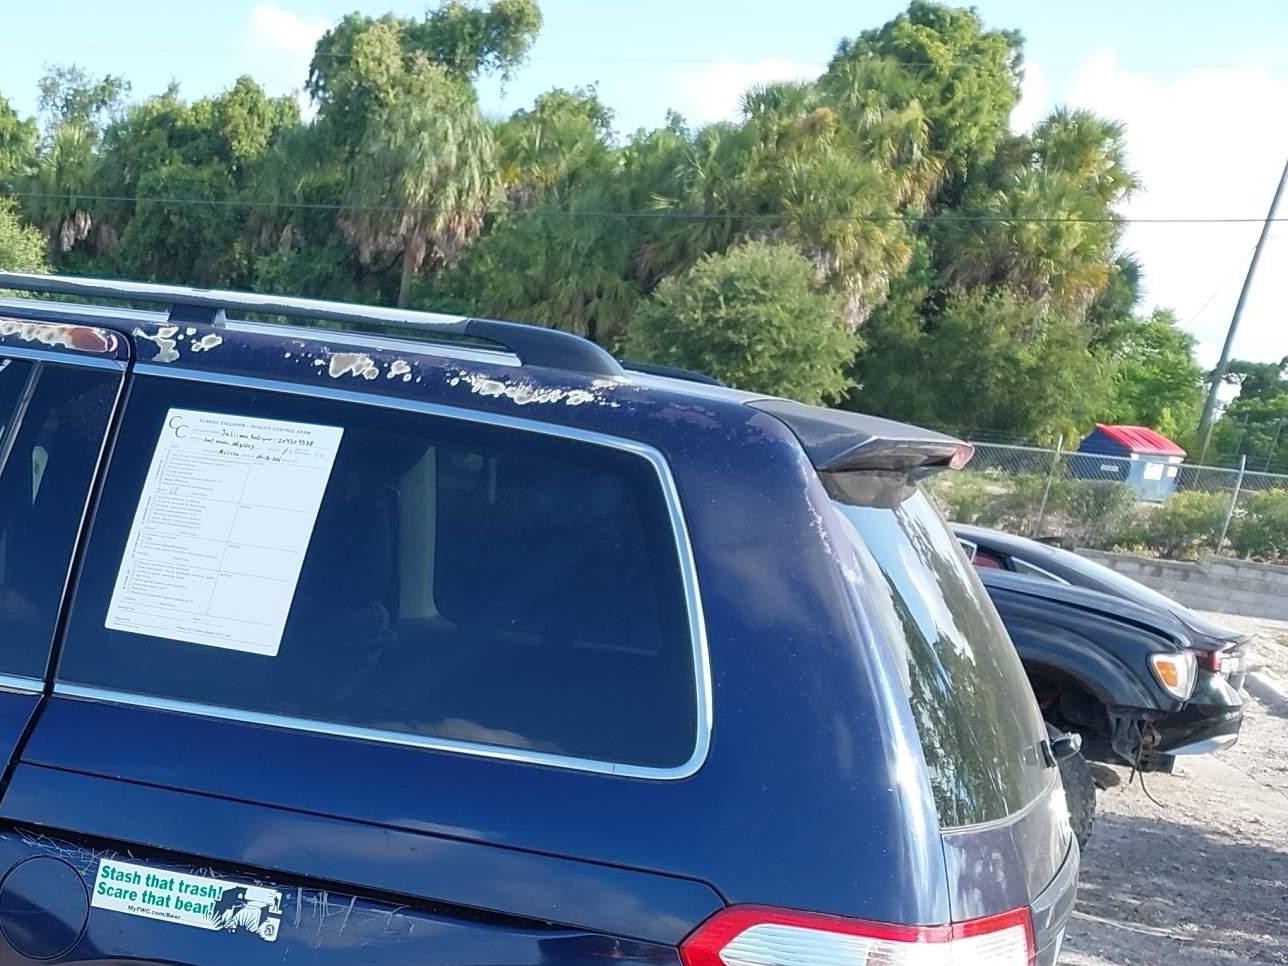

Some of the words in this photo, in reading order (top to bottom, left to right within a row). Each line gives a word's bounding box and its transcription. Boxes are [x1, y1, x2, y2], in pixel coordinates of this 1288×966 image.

[97, 881, 138, 901] Scare
[141, 890, 171, 907] that
[175, 898, 214, 916] bear!
[101, 865, 141, 885] Stash
[145, 873, 174, 891] that
[178, 880, 223, 900] trash!
